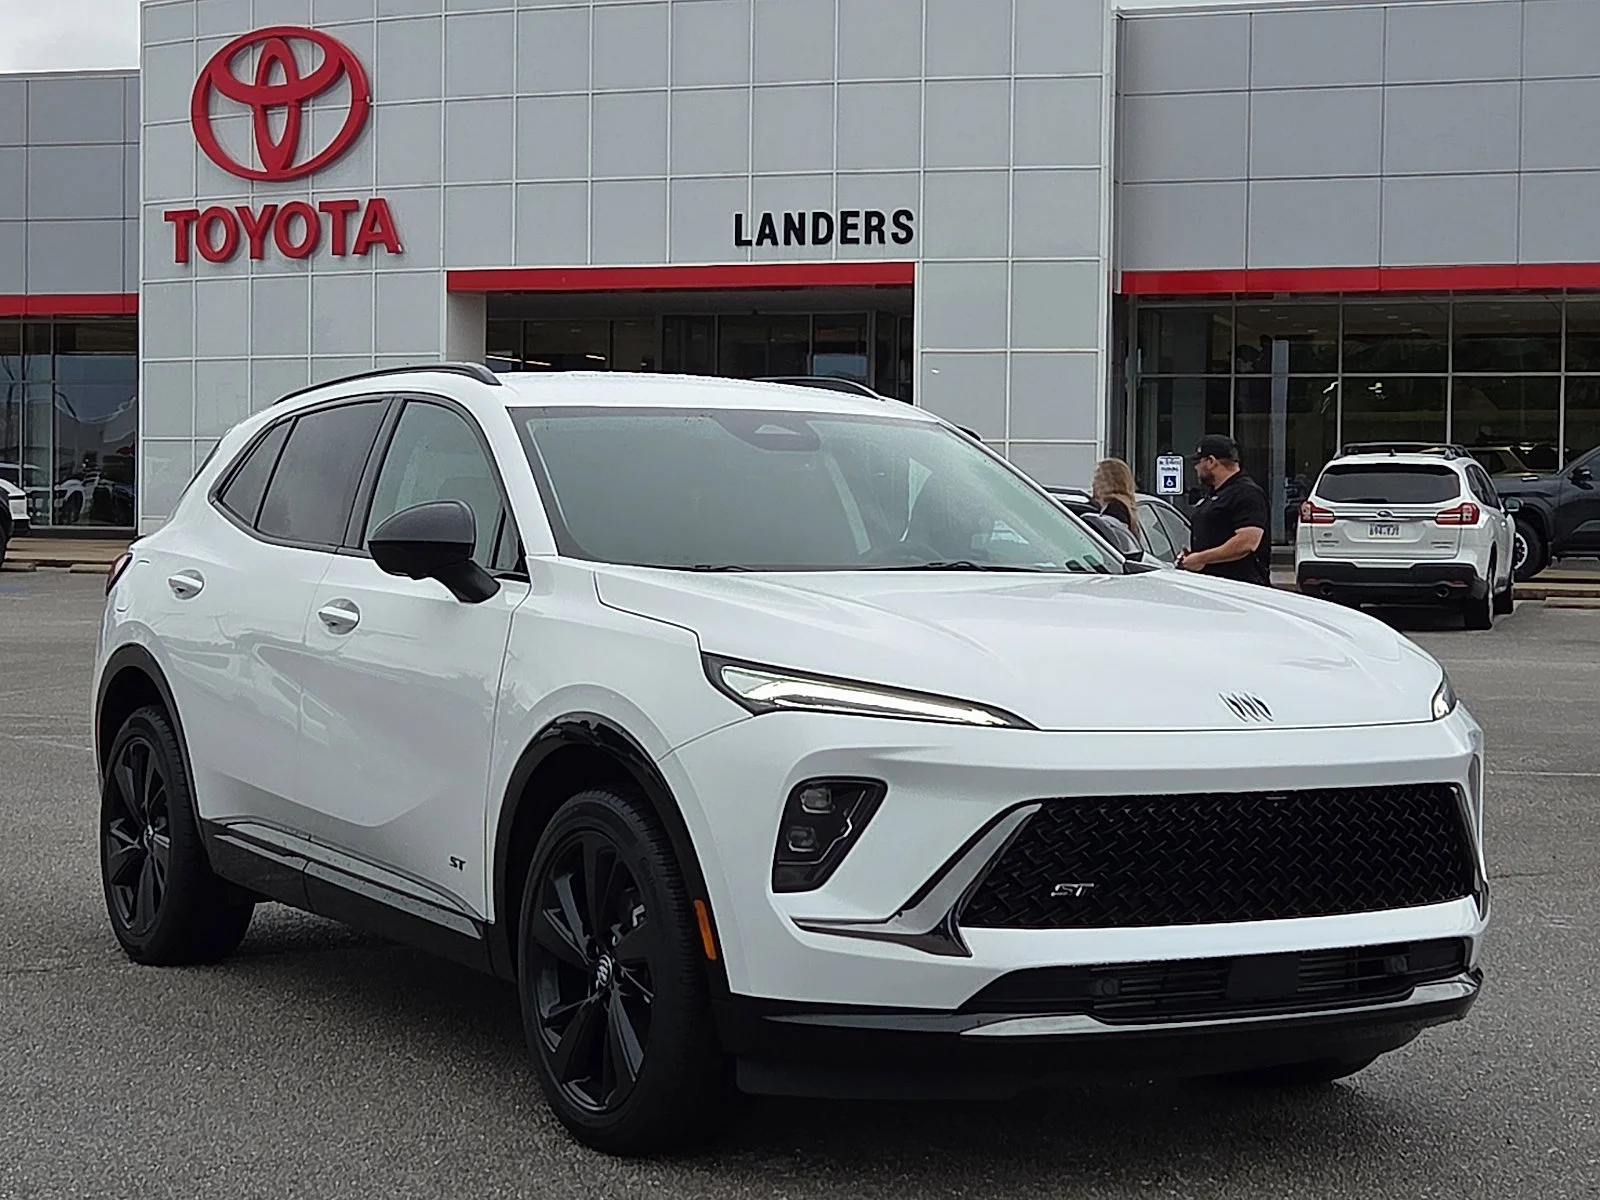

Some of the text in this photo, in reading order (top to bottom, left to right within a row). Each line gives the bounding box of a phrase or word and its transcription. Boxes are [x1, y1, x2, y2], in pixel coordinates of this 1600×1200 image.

[164, 198, 402, 263] TOYOTA
[734, 209, 914, 247] LANDERS
[449, 855, 466, 871] ST
[1050, 882, 1095, 897] ST
